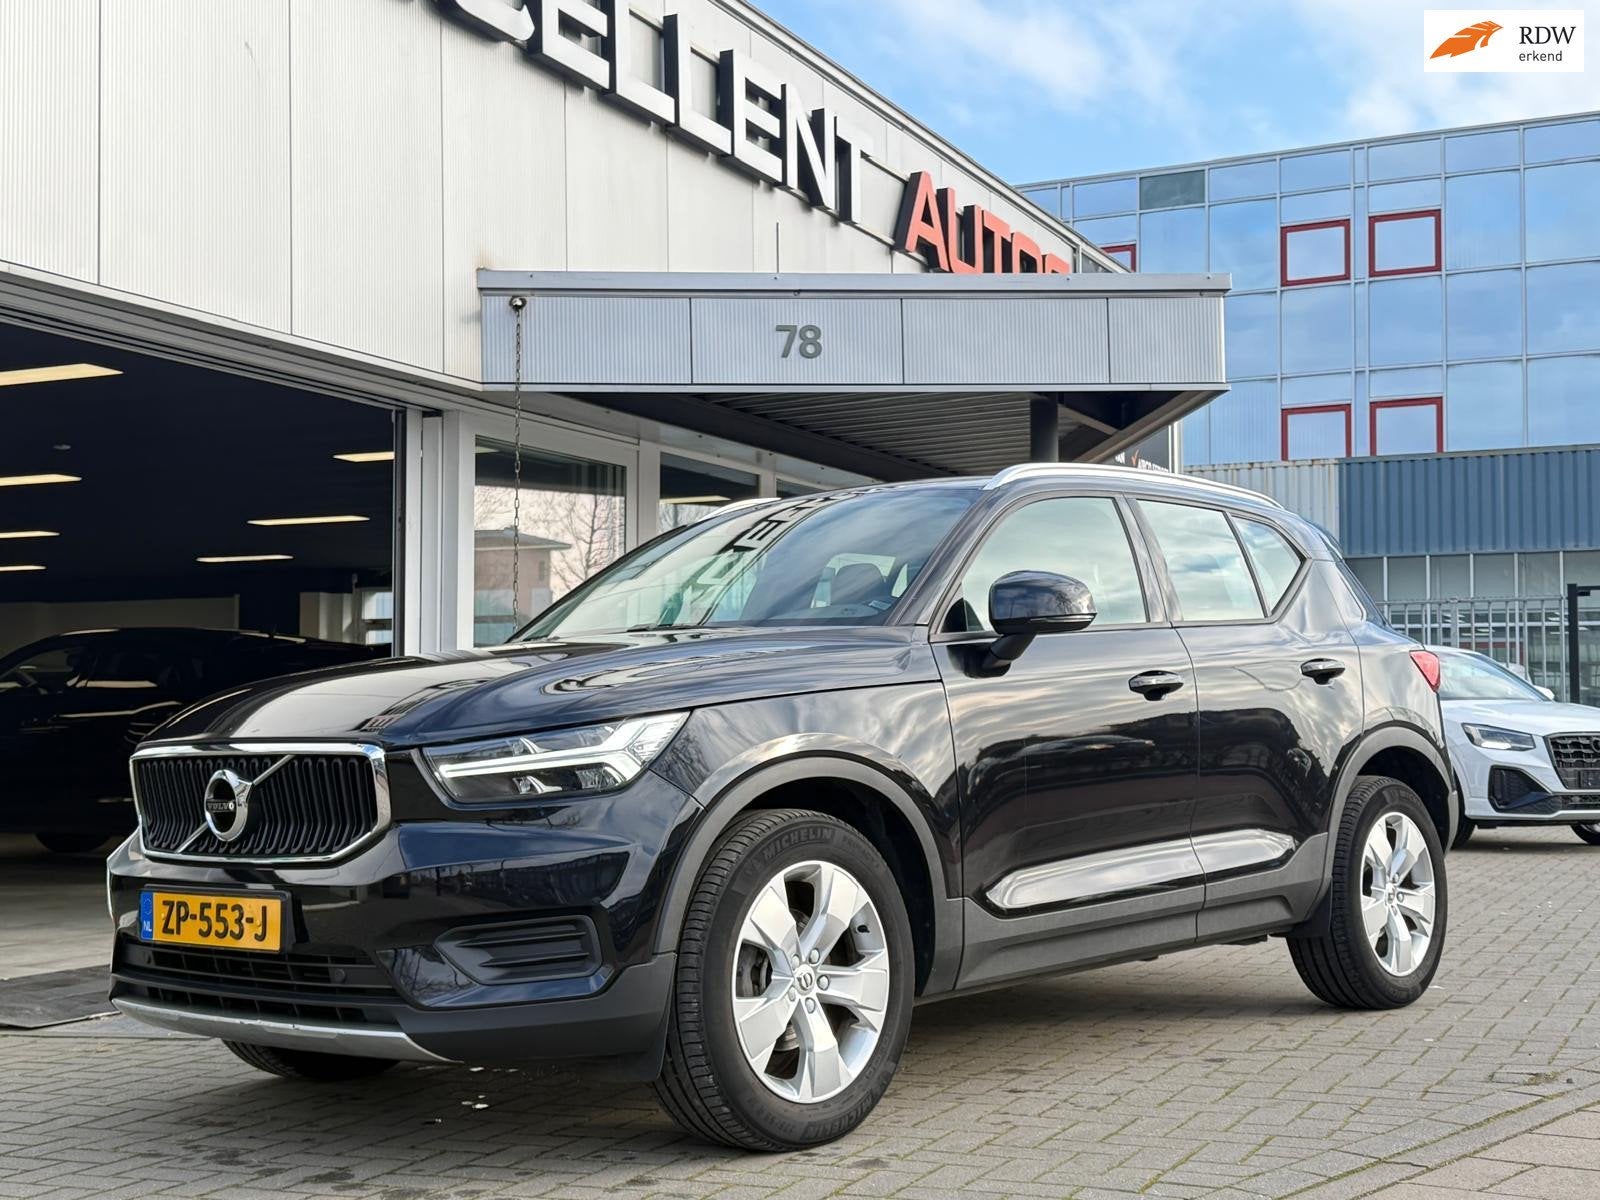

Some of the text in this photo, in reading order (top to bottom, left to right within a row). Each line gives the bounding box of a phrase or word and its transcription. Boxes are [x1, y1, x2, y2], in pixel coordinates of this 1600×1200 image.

[775, 324, 823, 359] 78
[207, 801, 235, 811] VOLVO
[763, 826, 833, 860] MICHELIN
[143, 900, 267, 942] NL ZP-553-J
